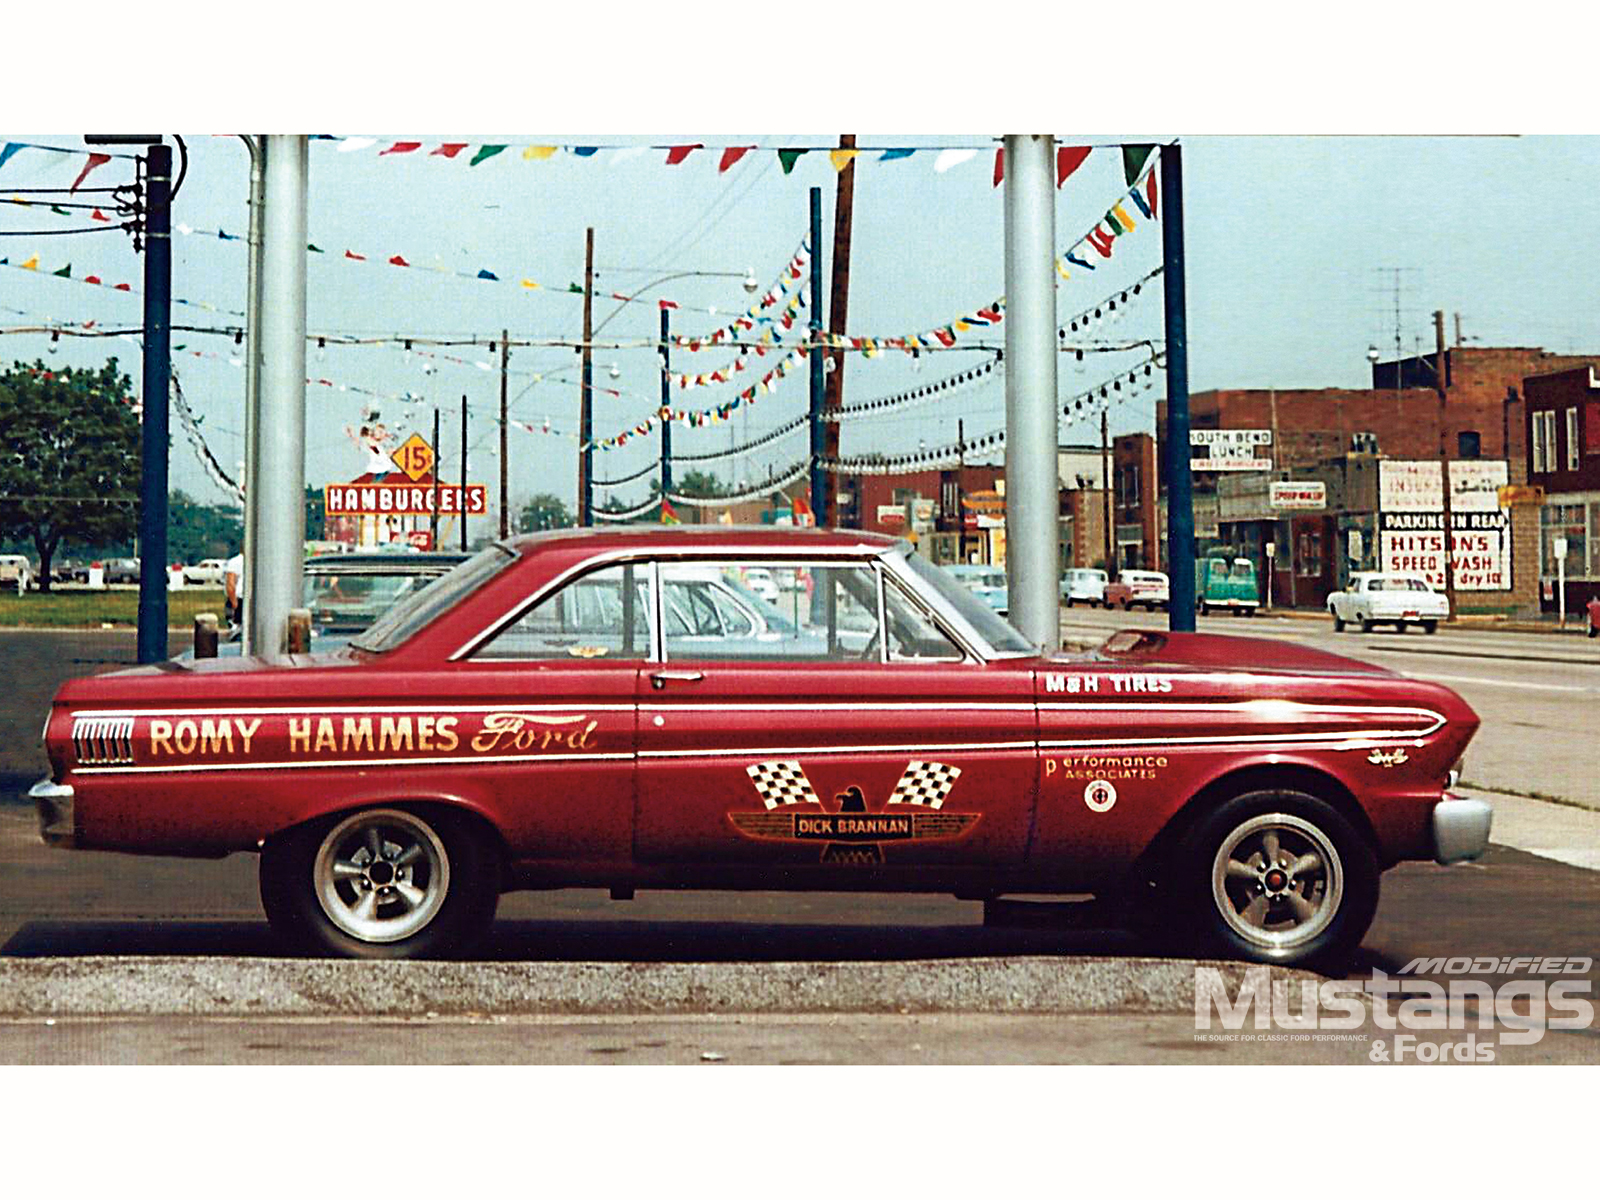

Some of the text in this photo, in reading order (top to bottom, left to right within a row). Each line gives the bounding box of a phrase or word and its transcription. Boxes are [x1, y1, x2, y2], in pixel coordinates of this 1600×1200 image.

[1235, 431, 1269, 443] BEND
[1212, 446, 1252, 458] LUNCH
[1385, 514, 1504, 529] PARKING IN REAR
[1391, 556, 1437, 571] SPEED
[1460, 572, 1482, 586] dry
[1109, 673, 1172, 693] TIRES
[150, 712, 598, 755] ROMY HAMMES Ford
[1065, 769, 1156, 780] ASSOCIATES
[799, 818, 909, 834] DICK BRANNAN
